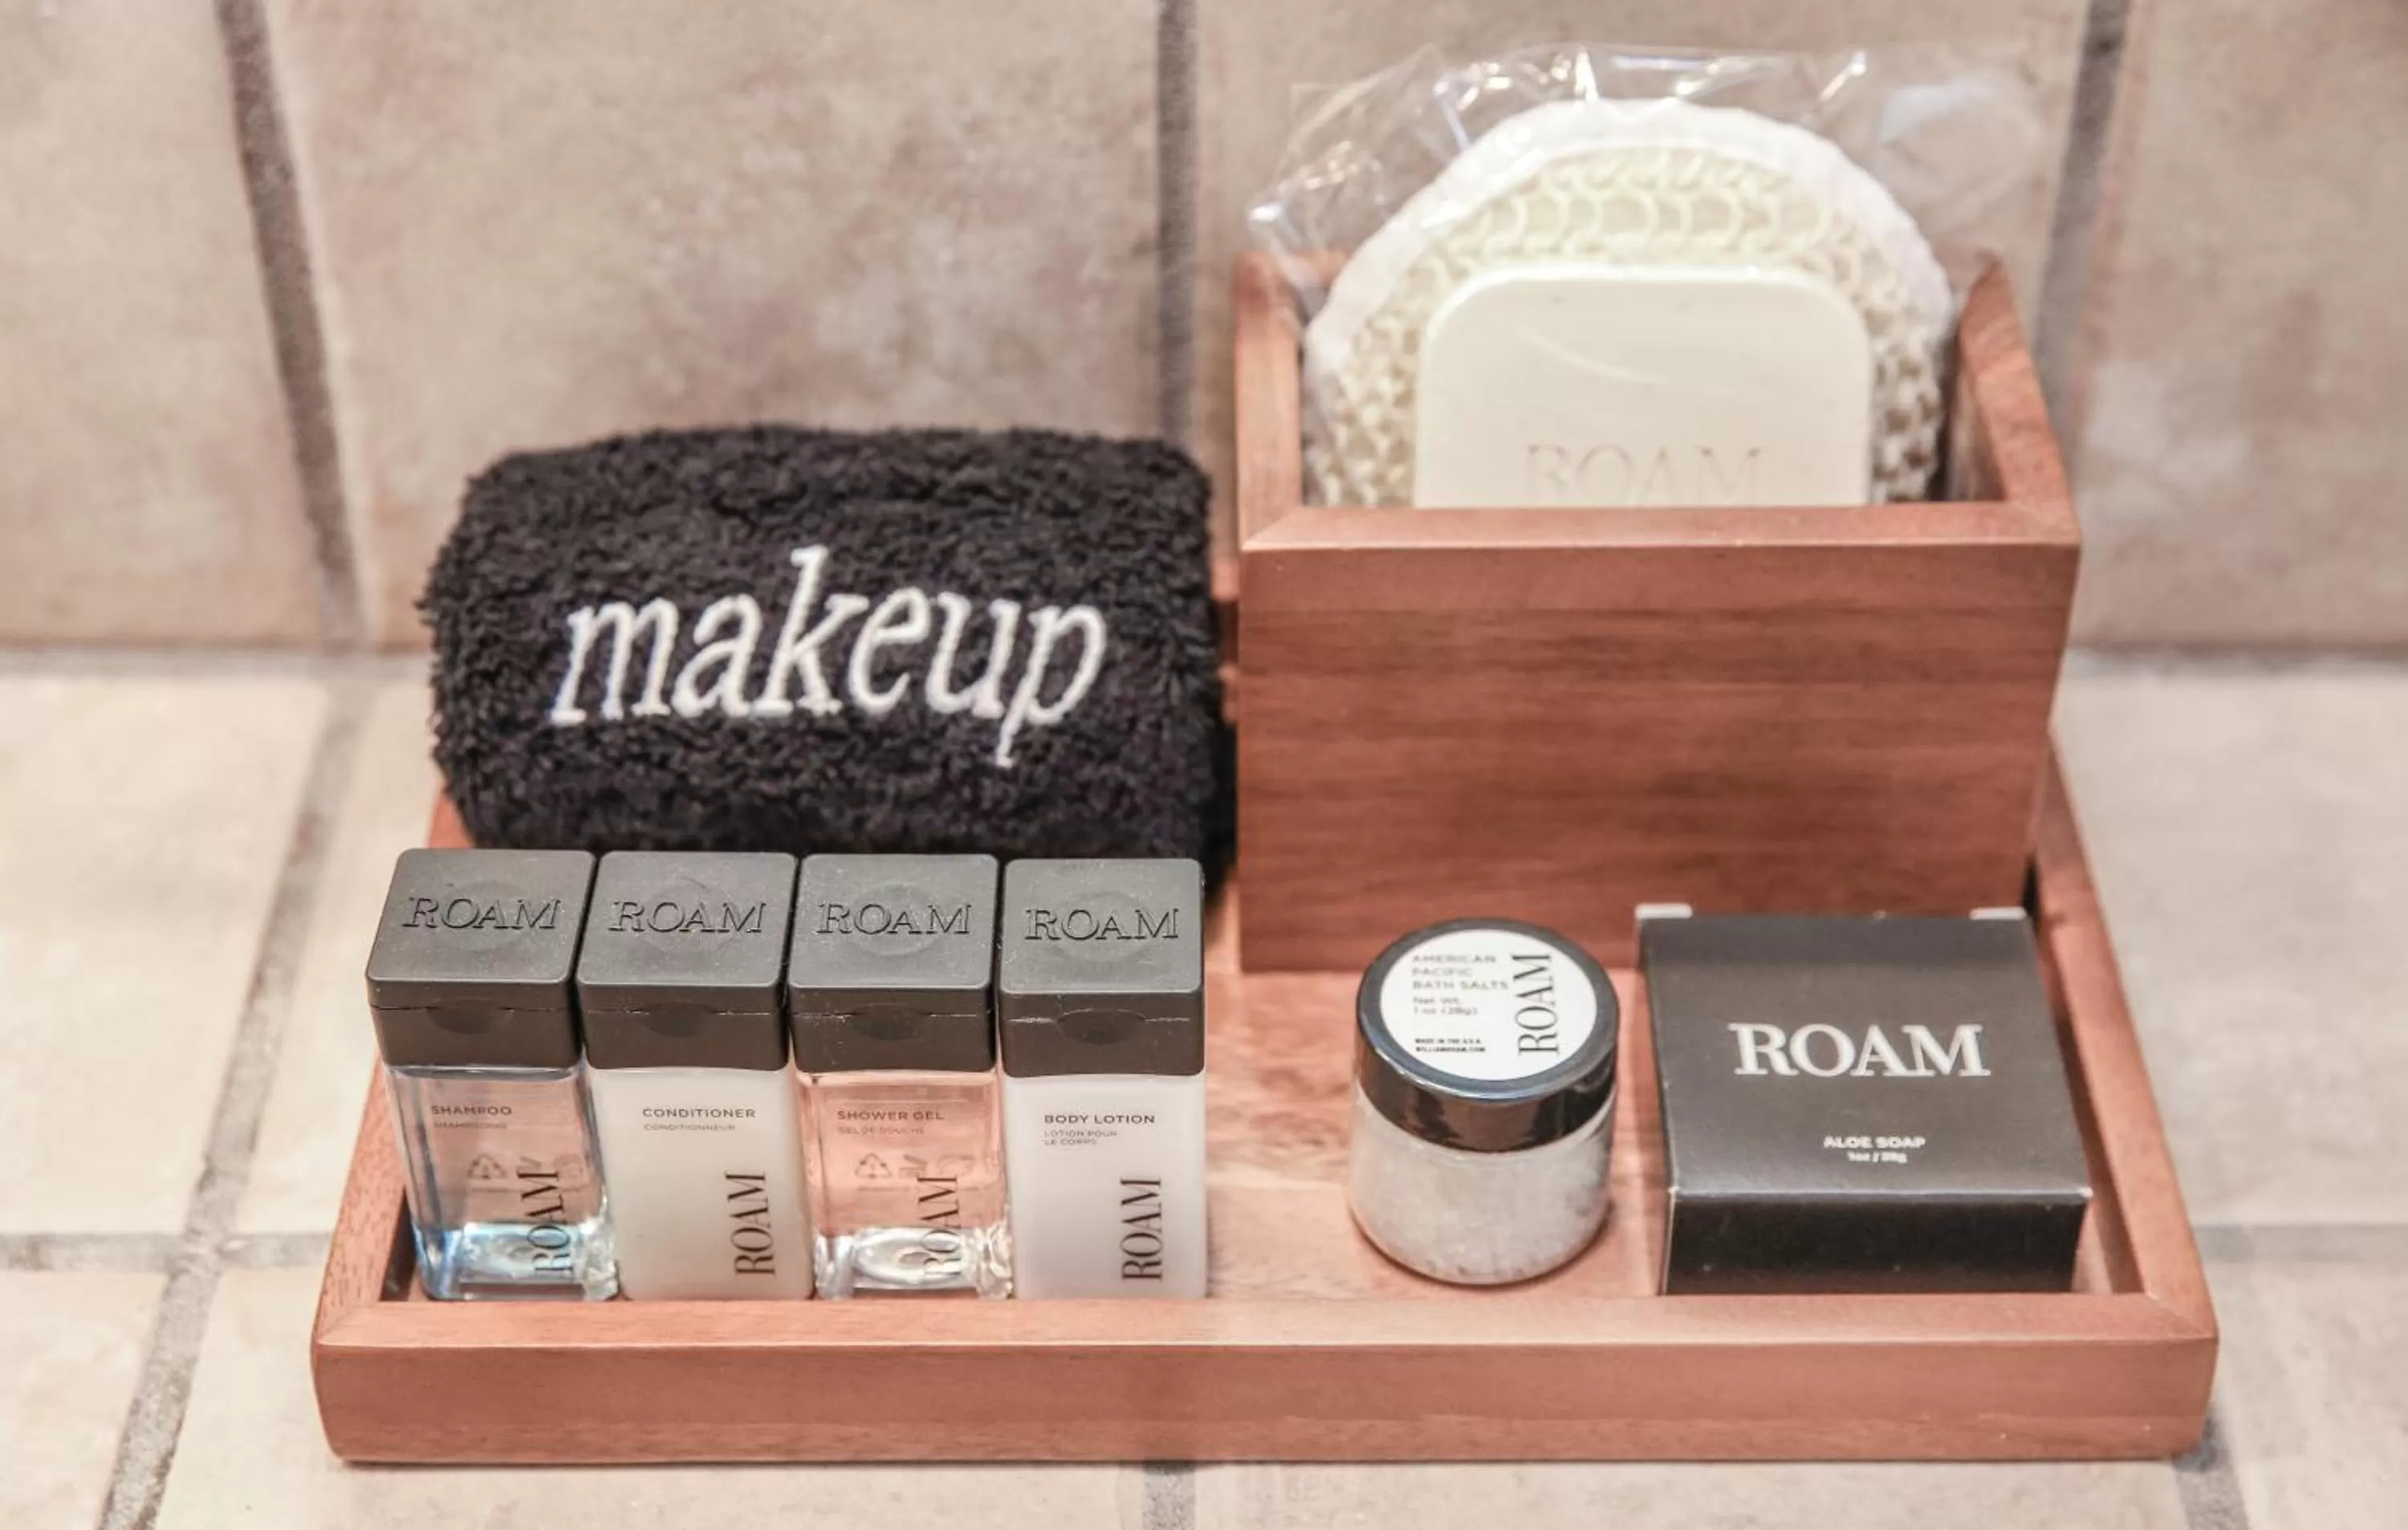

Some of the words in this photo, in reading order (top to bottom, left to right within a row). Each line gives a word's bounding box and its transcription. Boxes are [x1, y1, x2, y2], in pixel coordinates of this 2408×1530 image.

[1525, 443, 1769, 507] ROAM
[551, 544, 1107, 767] makeup
[402, 897, 561, 930] ROAM
[608, 901, 767, 934] ROAM
[816, 903, 972, 935] ROAM
[1024, 908, 1179, 940] ROAM
[1412, 953, 1497, 963] AMERICAN
[1412, 966, 1474, 977] PACIFIC
[1413, 980, 1455, 990] BATH
[1460, 980, 1509, 990] SALTS
[1511, 952, 1560, 1056] ROAM
[1727, 1022, 1991, 1077] ROAM
[431, 1105, 513, 1116] SHAMPOO
[642, 1108, 756, 1118] CONDITIONER
[837, 1110, 909, 1121] SHOWER
[913, 1110, 945, 1121] GEL
[1044, 1114, 1089, 1124] BODY
[1094, 1114, 1156, 1125] LOTION
[1044, 1129, 1084, 1138] LOTION
[1823, 1135, 1873, 1149] ALOE
[1875, 1135, 1926, 1149] SOAP
[518, 1169, 573, 1276] ROAM
[724, 1170, 775, 1278] ROAM
[916, 1174, 962, 1278] ROAM
[1120, 1178, 1164, 1282] ROAM
